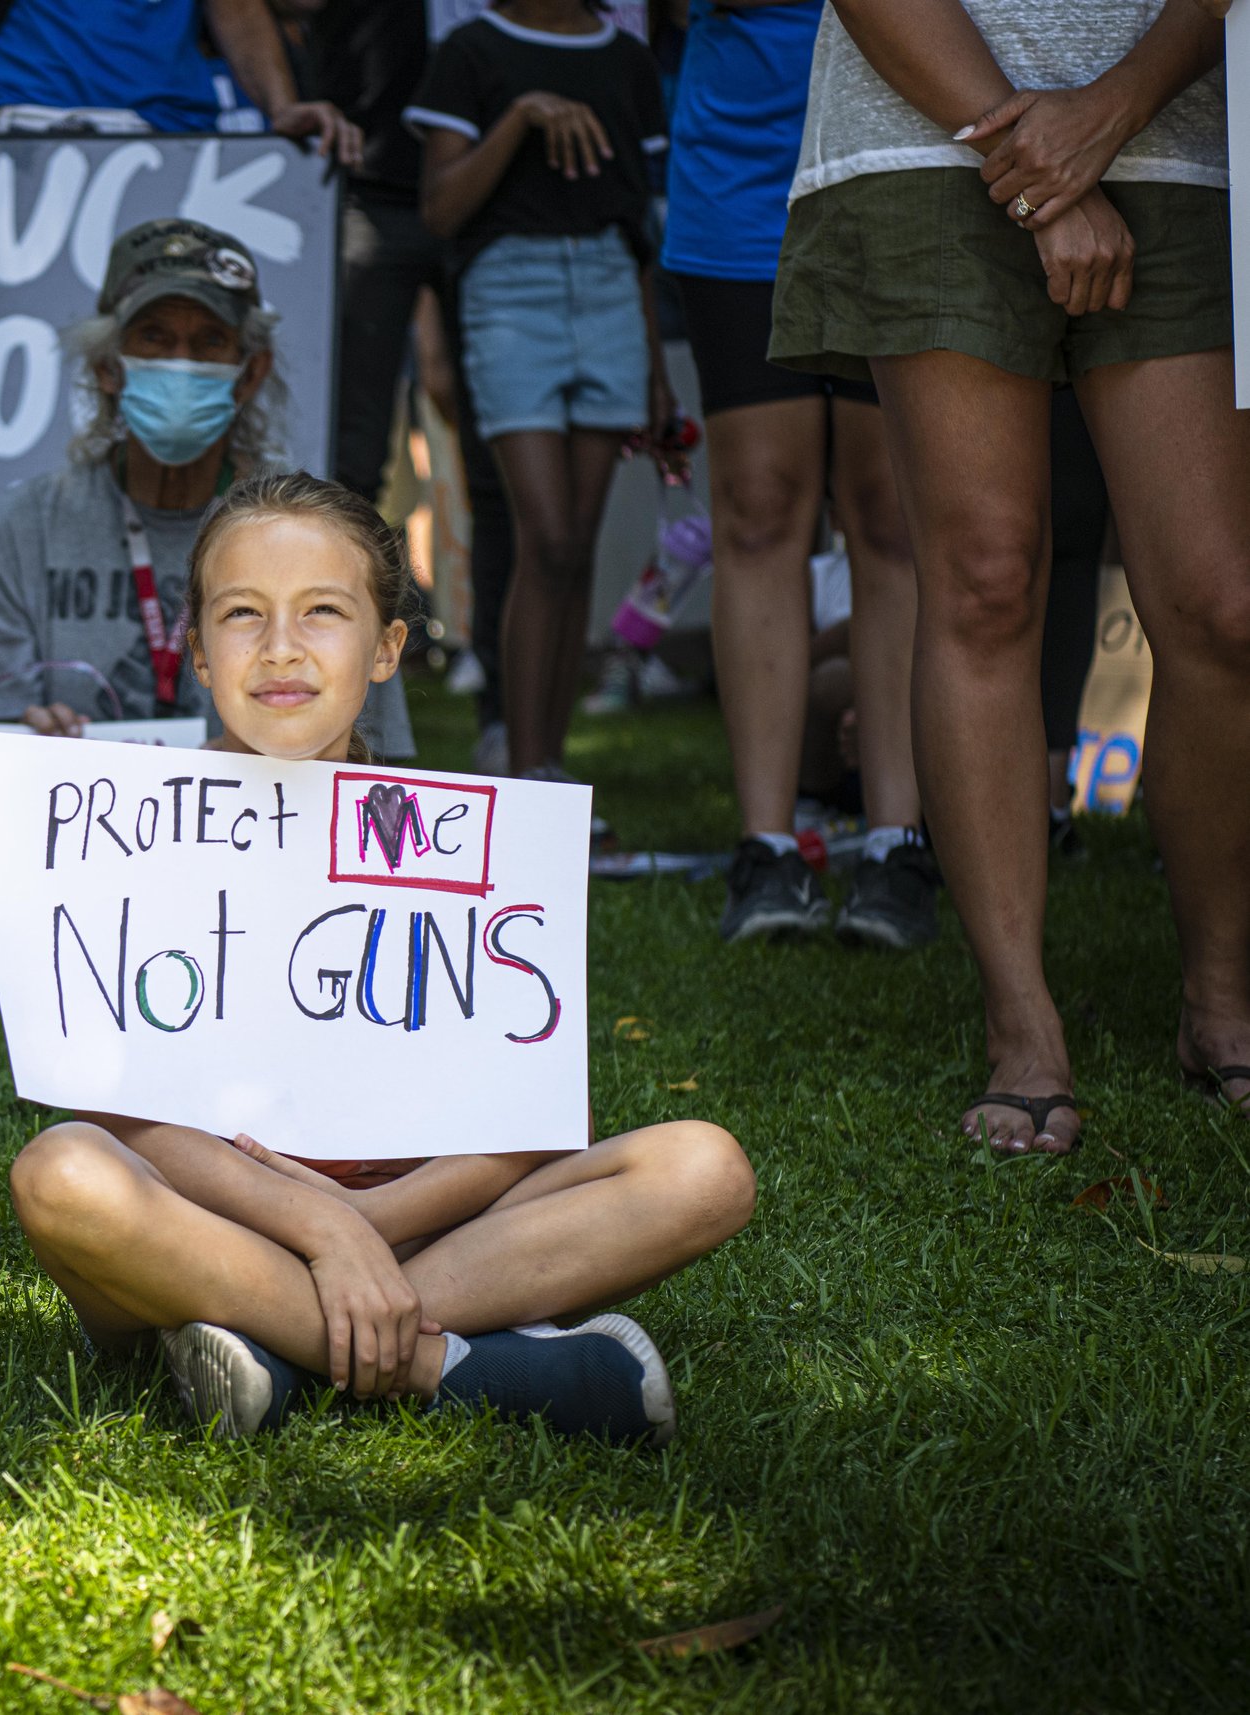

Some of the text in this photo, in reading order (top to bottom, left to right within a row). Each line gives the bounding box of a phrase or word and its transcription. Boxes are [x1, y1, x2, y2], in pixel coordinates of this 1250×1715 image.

[47, 567, 98, 620] NO
[356, 783, 469, 874] Me
[53, 890, 562, 1045] Not GUNS
